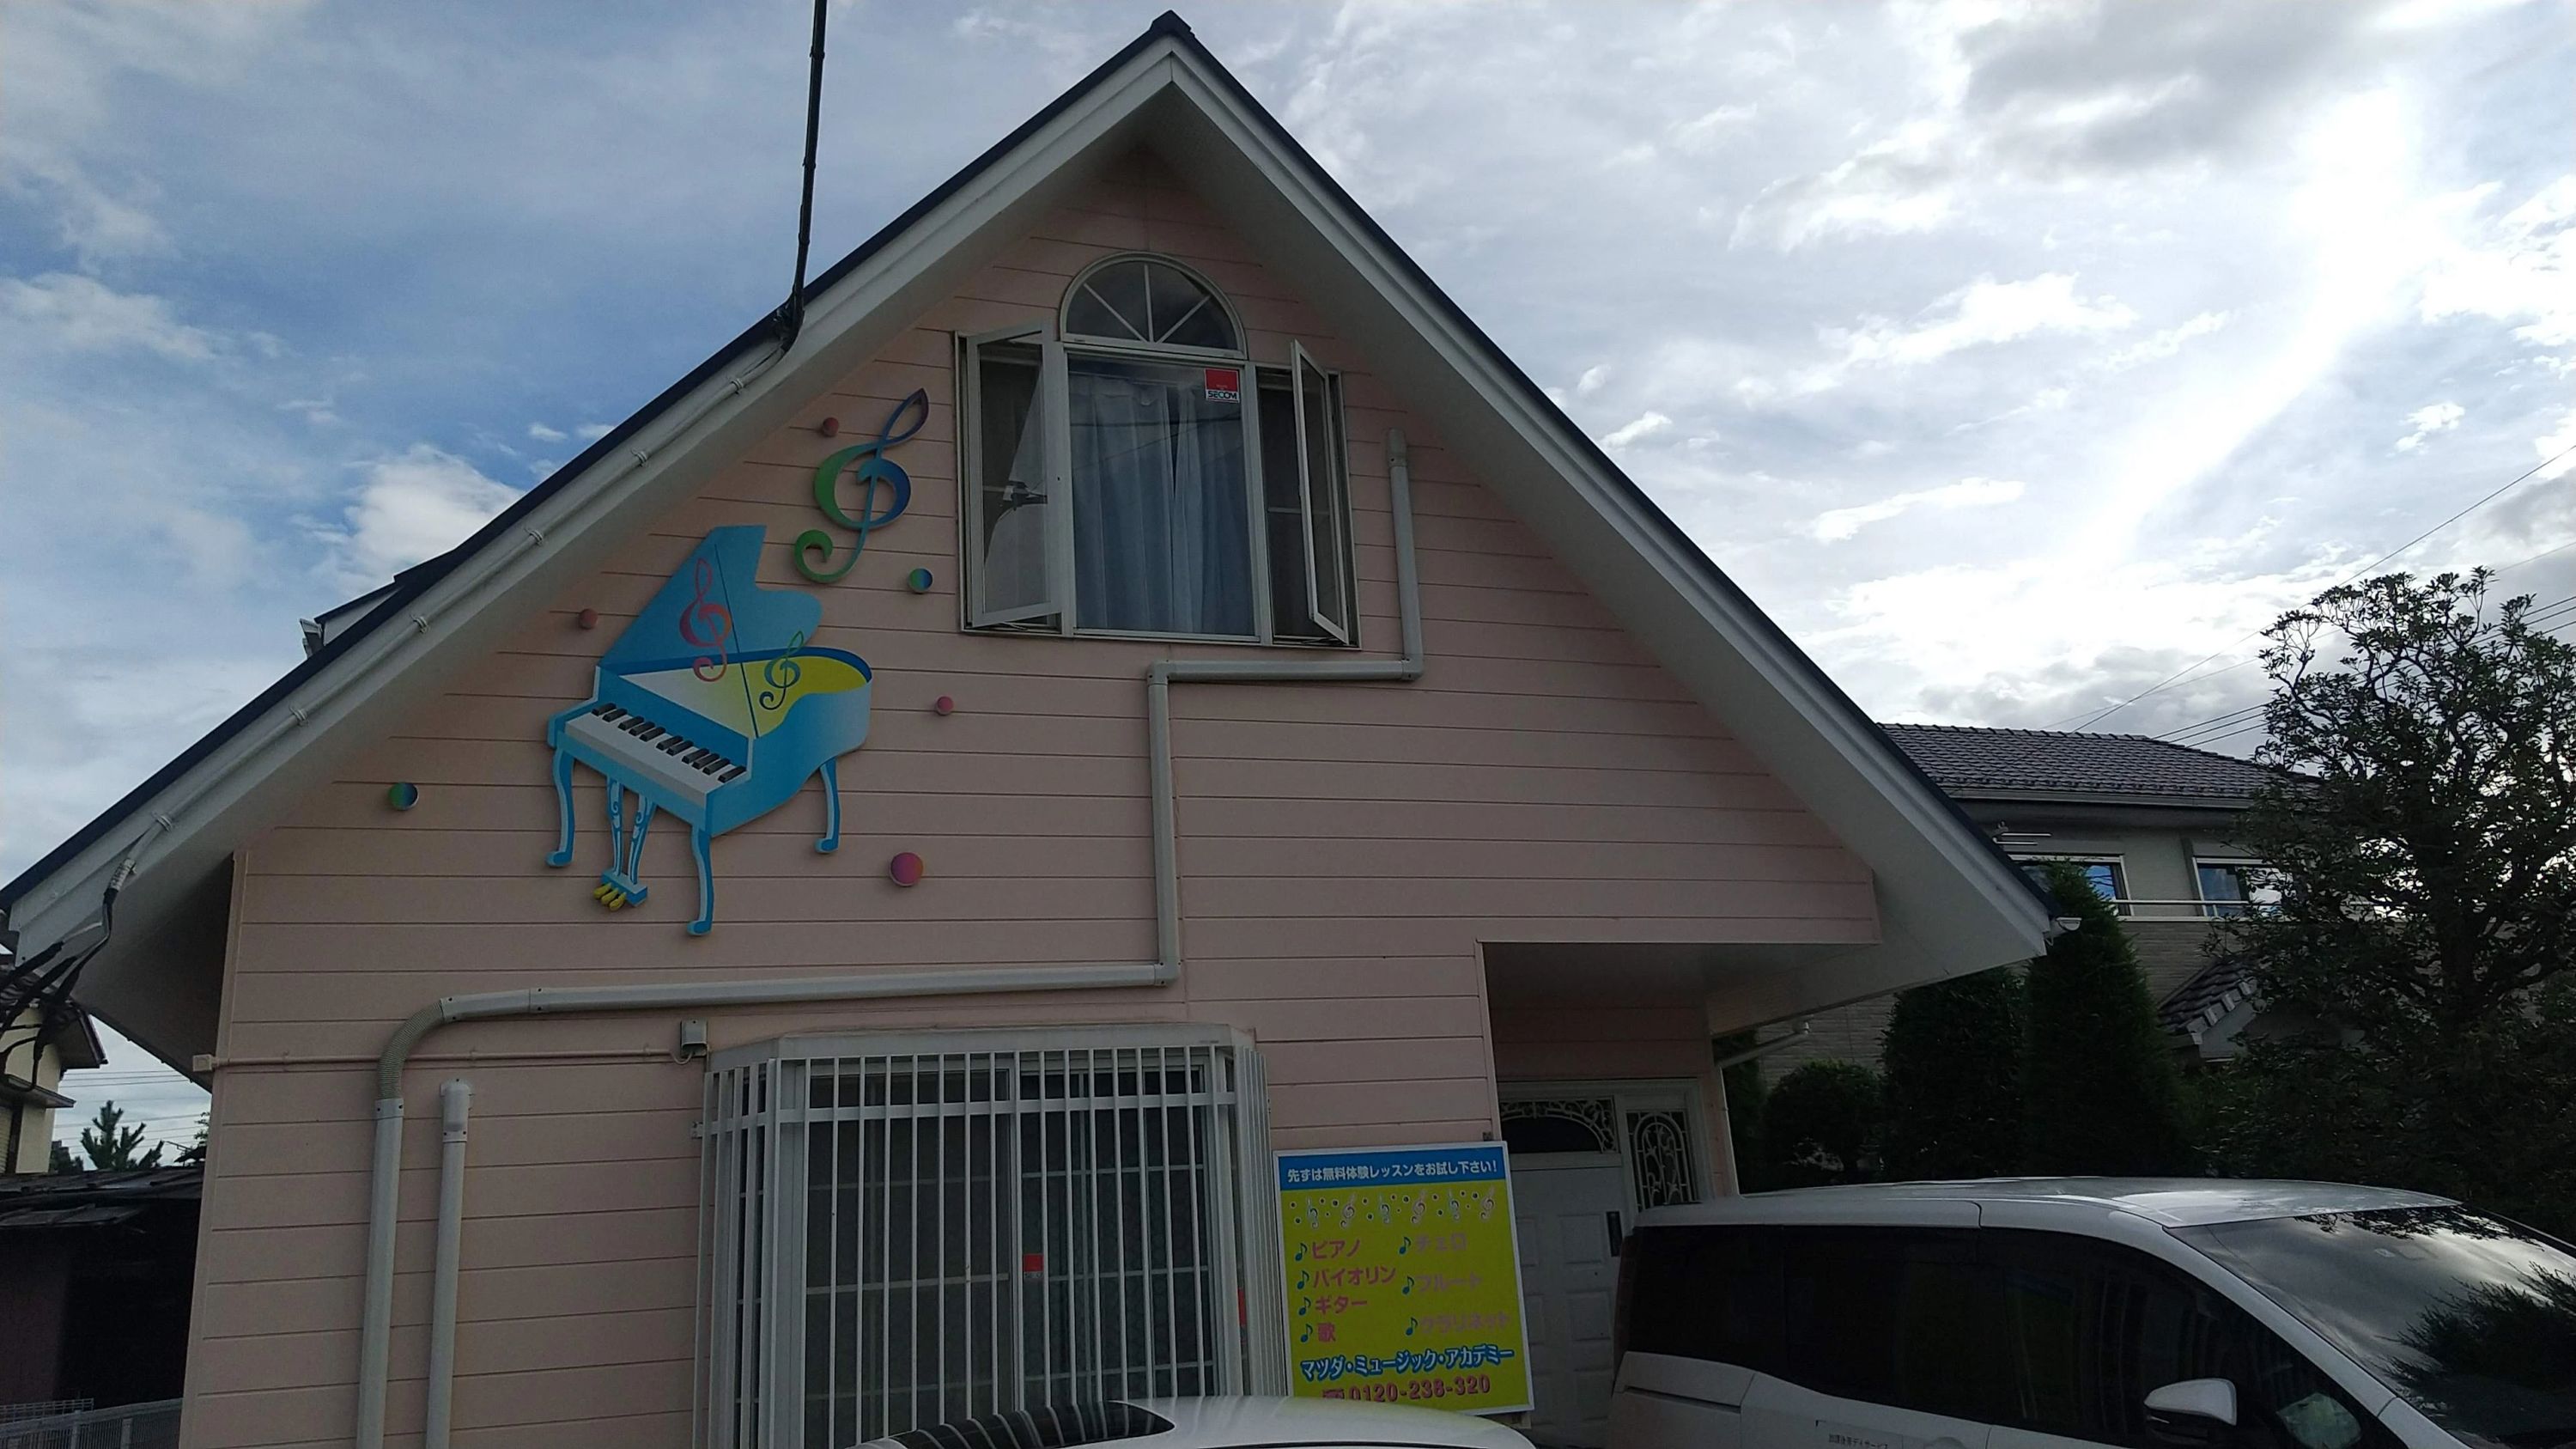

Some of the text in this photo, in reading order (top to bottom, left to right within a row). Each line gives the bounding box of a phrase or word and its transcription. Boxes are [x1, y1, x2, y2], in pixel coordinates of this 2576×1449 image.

[1208, 391, 1237, 399] SECOM
[1312, 1239, 1360, 1259] ピアノ
[1415, 1233, 1467, 1253] チェロ
[1313, 1265, 1396, 1288] バイオリン
[1416, 1272, 1483, 1293] フルート
[1315, 1294, 1368, 1315] ギター
[1316, 1322, 1336, 1342] 歌
[1300, 1342, 1515, 1381] マツダ・ミュージック・アカデミー
[1348, 1373, 1492, 1403] 0120-238-320
